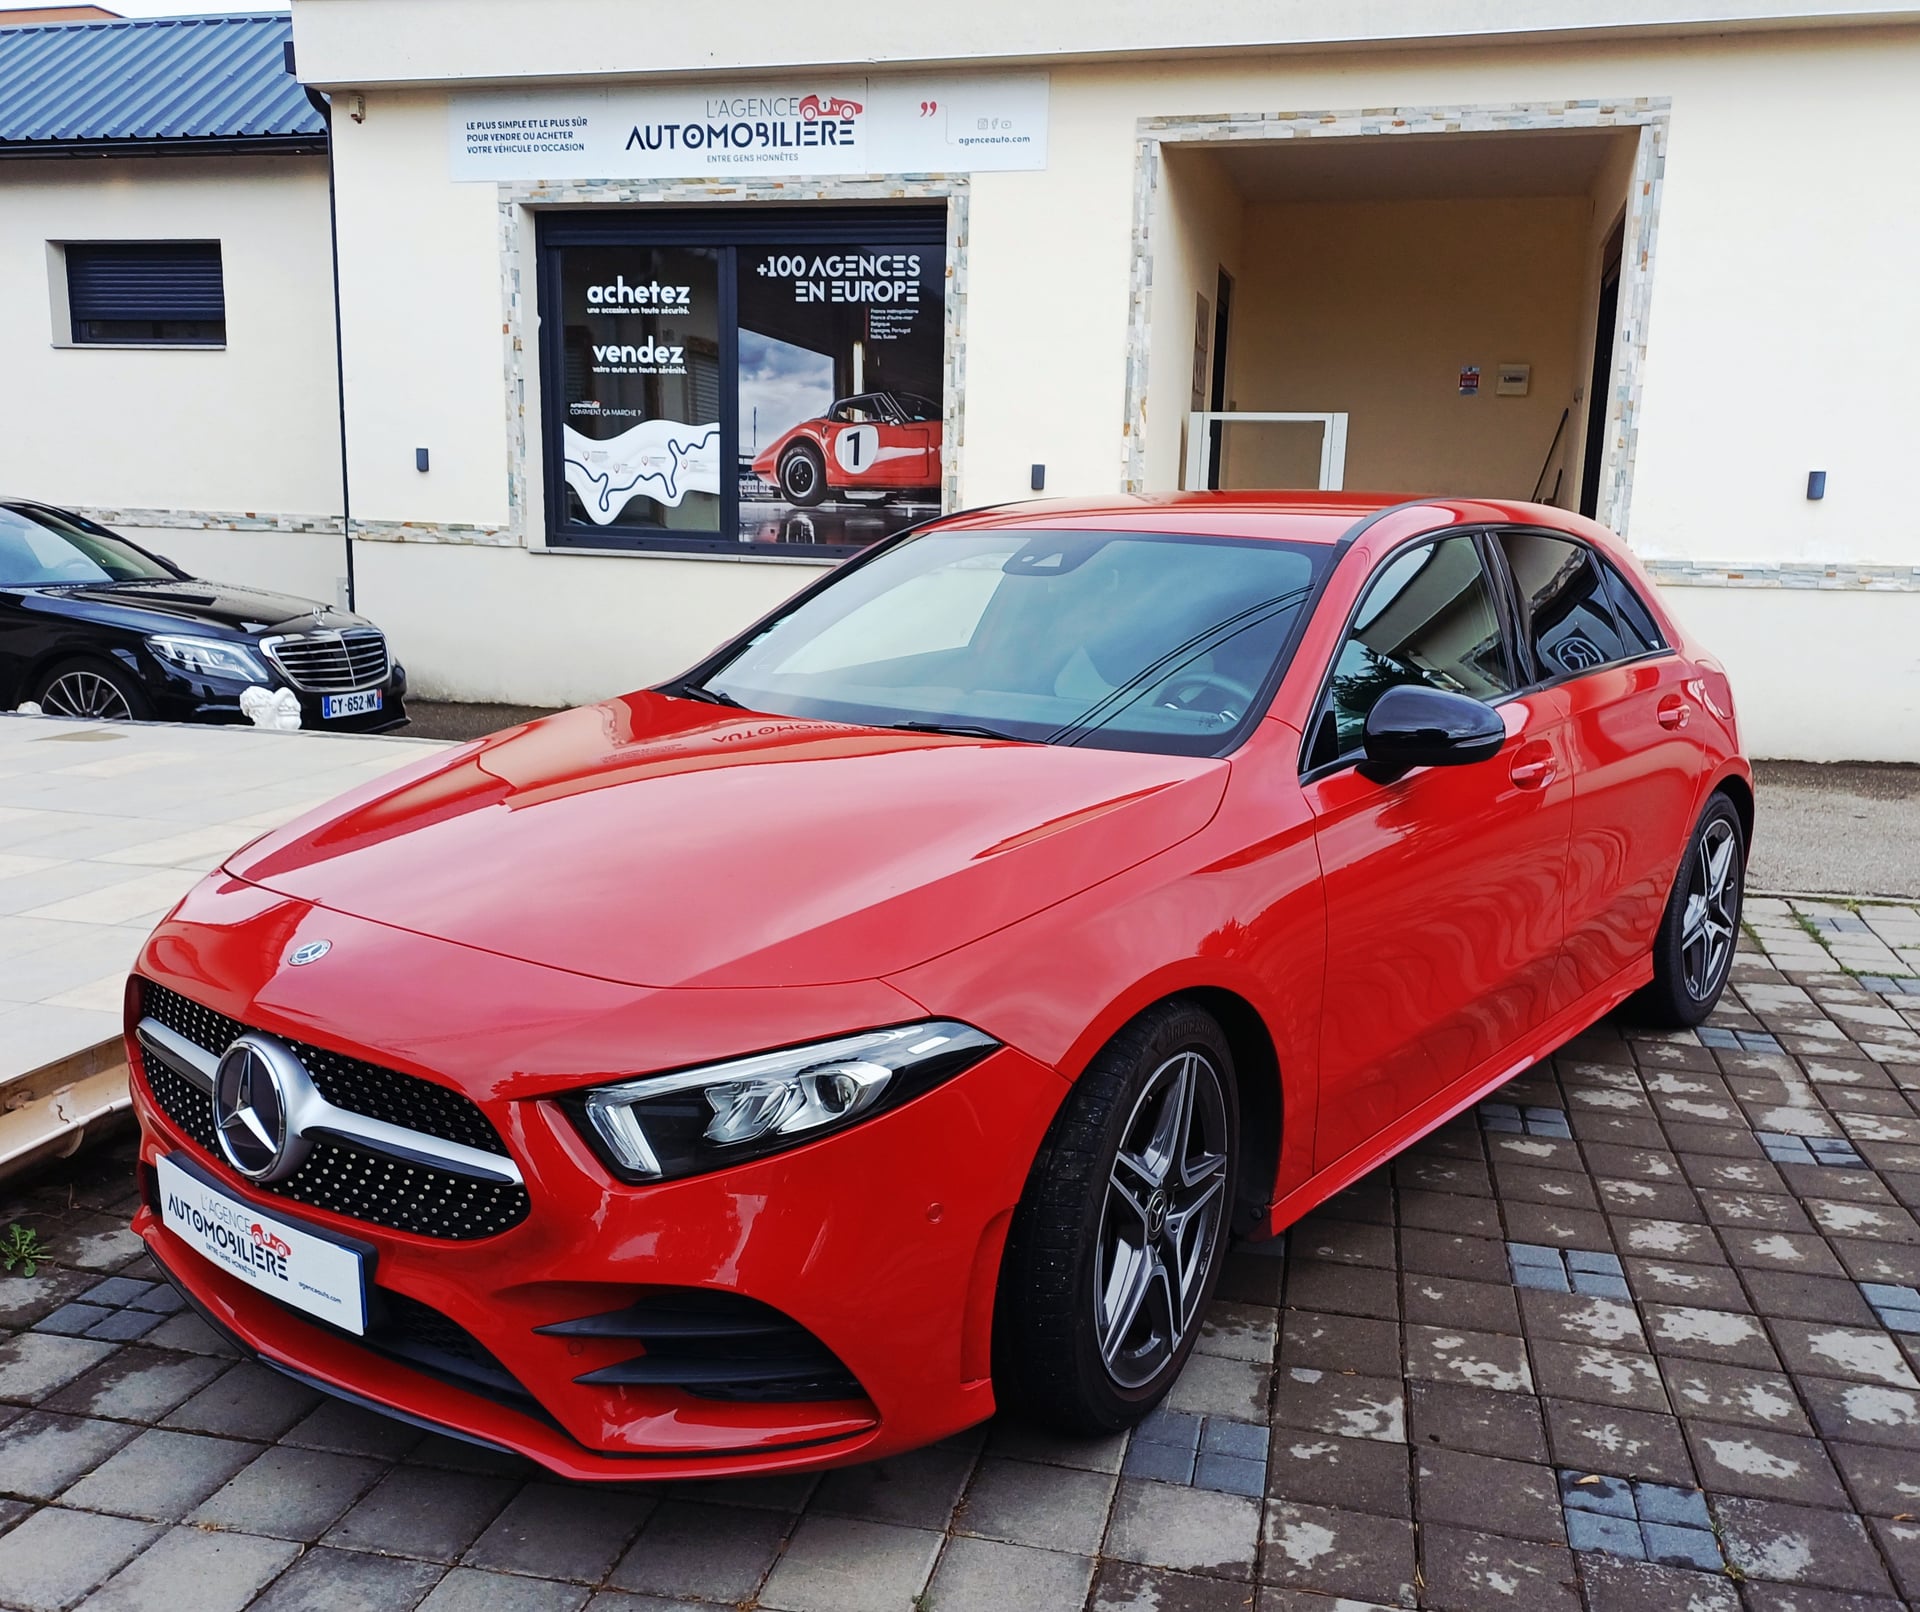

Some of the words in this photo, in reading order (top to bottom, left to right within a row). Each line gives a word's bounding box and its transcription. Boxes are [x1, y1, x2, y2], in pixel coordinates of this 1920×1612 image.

[706, 97, 800, 119] L'AGENCE
[466, 122, 475, 130] LE
[477, 121, 496, 130] PLUS
[497, 120, 526, 129] SIMPLE
[528, 120, 537, 128] ET
[539, 120, 548, 128] LE
[550, 119, 570, 127] PLUS
[466, 134, 489, 142] POUR
[490, 133, 521, 141] VENDRE
[522, 132, 535, 140] OU
[536, 131, 574, 140] ACHETER
[958, 135, 1031, 145] agenceauto.com
[466, 146, 492, 154] VOTRE
[706, 155, 731, 163] ENTRE
[733, 154, 754, 162] GENS
[756, 152, 799, 162] HONNÊTES
[756, 256, 806, 277] +100
[808, 255, 921, 277] AGENCES
[586, 275, 691, 304] achetez
[795, 281, 825, 302] EN
[831, 281, 920, 302] EUROPE
[601, 305, 630, 314] occasion
[641, 306, 660, 314] toute
[592, 335, 685, 364] vendez
[638, 366, 657, 374] toute
[570, 408, 601, 416] COMMENT
[846, 431, 861, 466] 1
[201, 1193, 252, 1237] L'AGENCE
